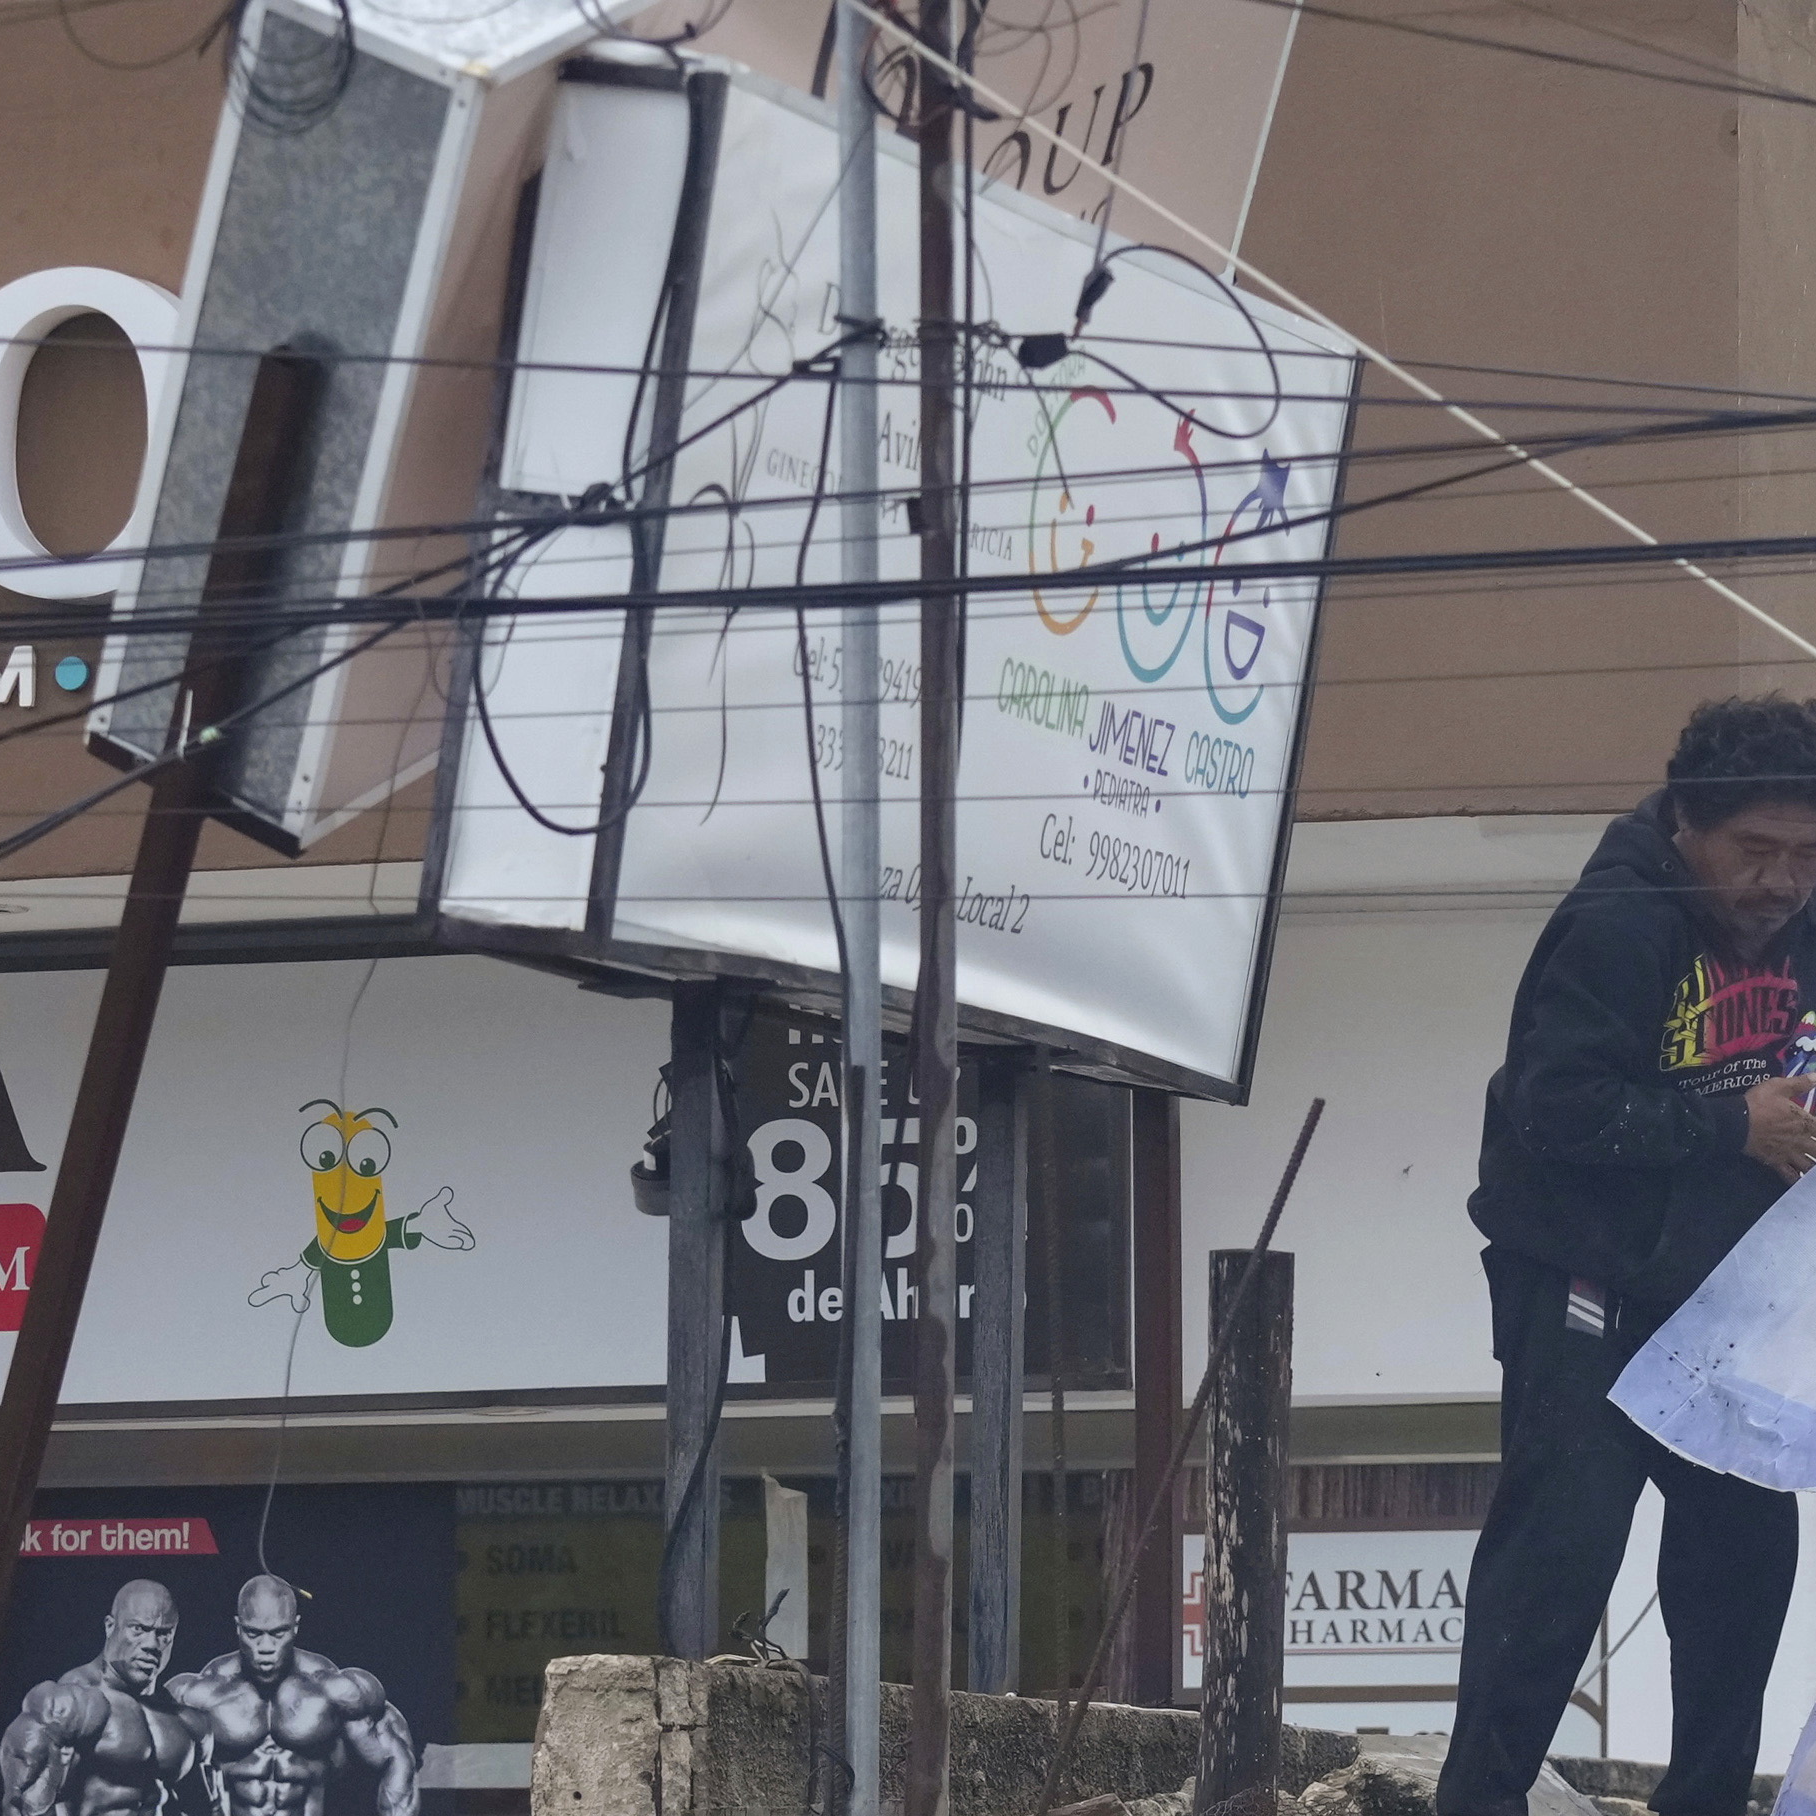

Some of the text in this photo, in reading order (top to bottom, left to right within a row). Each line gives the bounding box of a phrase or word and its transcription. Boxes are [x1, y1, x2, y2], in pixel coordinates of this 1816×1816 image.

[997, 657, 1254, 799] CAROLINA JIMENEZ CASTRO
[1093, 769, 1150, 818] PEDIATRA
[1040, 813, 1191, 899] Cel: 9982307011
[957, 876, 1016, 932] Local
[1011, 892, 1031, 935] 2
[788, 1061, 888, 1108] SAE
[1679, 1058, 1767, 1089] Tour Of The
[1695, 1072, 1771, 1096] MERICAS
[787, 1269, 844, 1323] de
[454, 1486, 565, 1514] MUSCLE
[51, 1523, 92, 1551] for
[100, 1522, 190, 1550] them!
[1285, 1568, 1466, 1612] ARMA
[1289, 1617, 1464, 1644] HARMAC
